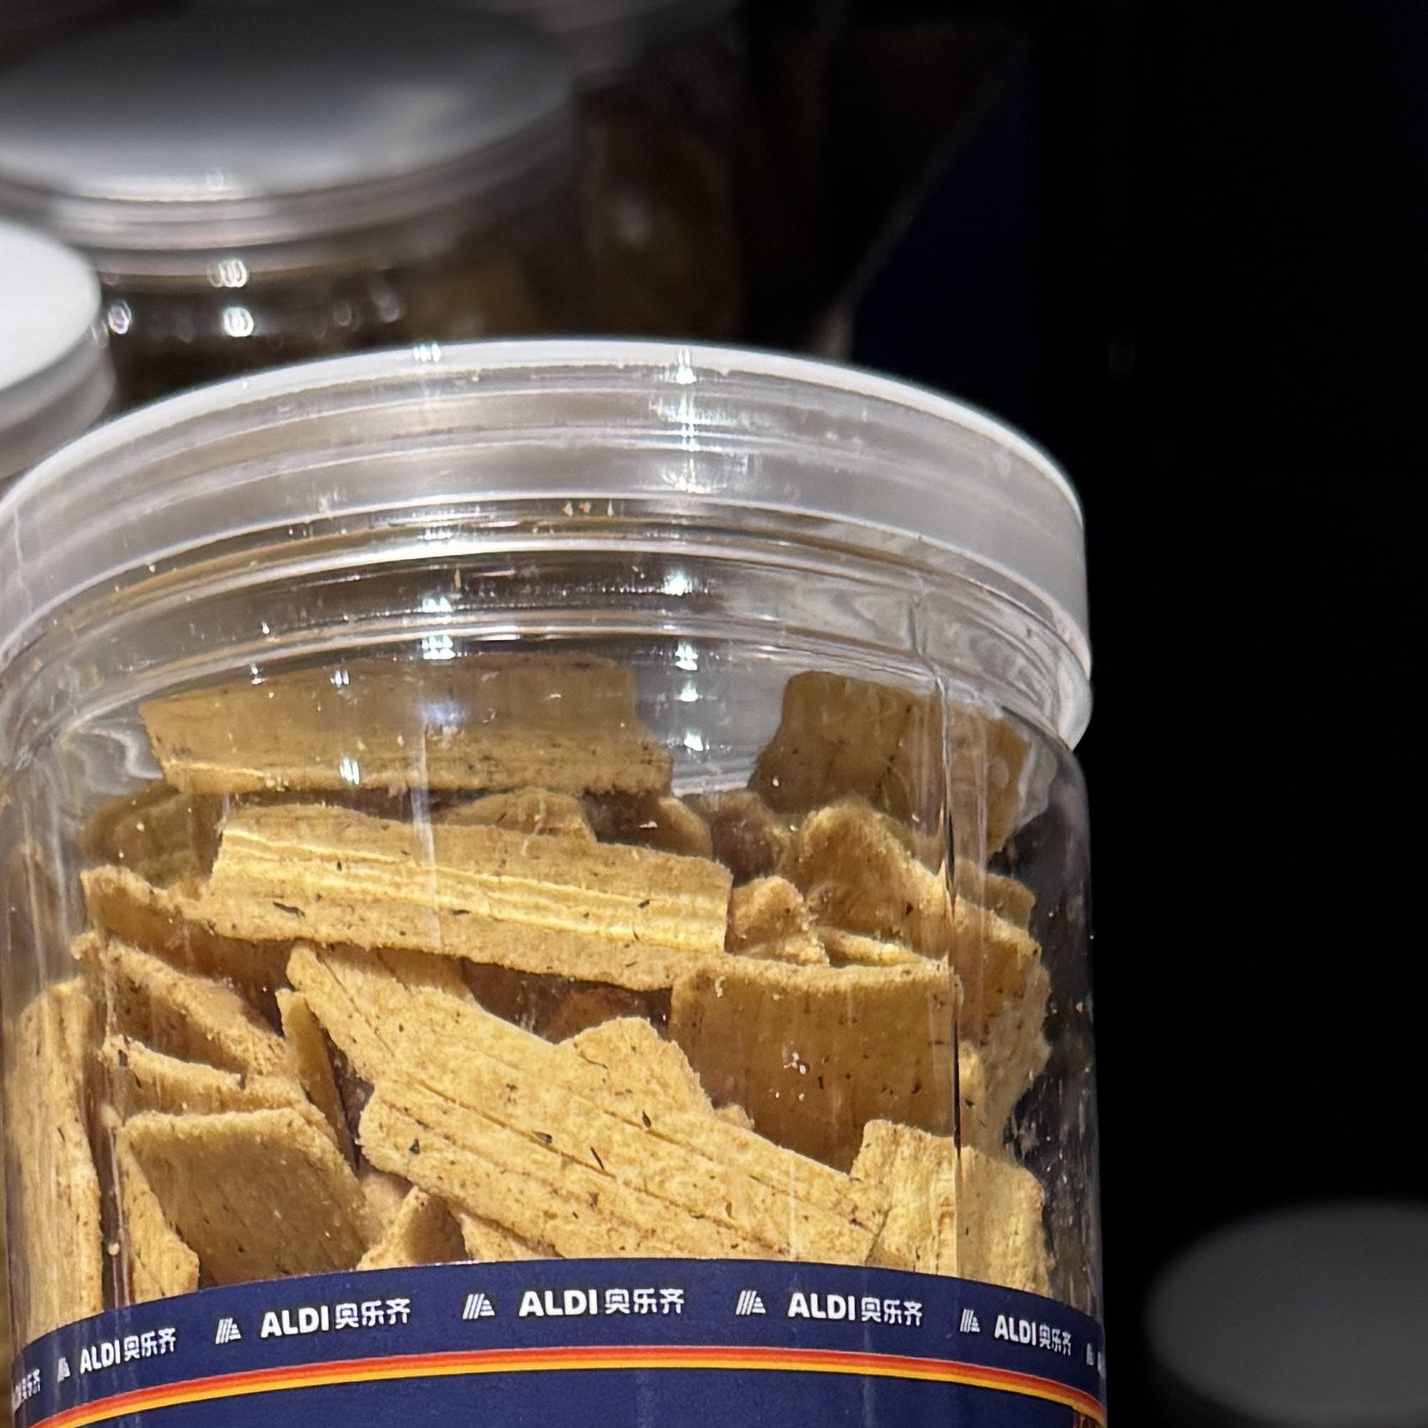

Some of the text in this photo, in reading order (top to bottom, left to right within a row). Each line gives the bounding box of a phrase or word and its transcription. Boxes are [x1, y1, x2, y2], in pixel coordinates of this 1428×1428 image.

[80, 1340, 120, 1374] ALDI
[124, 1328, 176, 1361] 奥乐齐
[260, 1306, 329, 1338] ALDI
[335, 1298, 411, 1329] 奥乐齐
[518, 1289, 597, 1317] ALDI
[604, 1287, 685, 1315] 奥乐齐
[787, 1292, 855, 1321] ALDI
[861, 1297, 922, 1326] 奥乐齐
[994, 1314, 1036, 1346] ALDI
